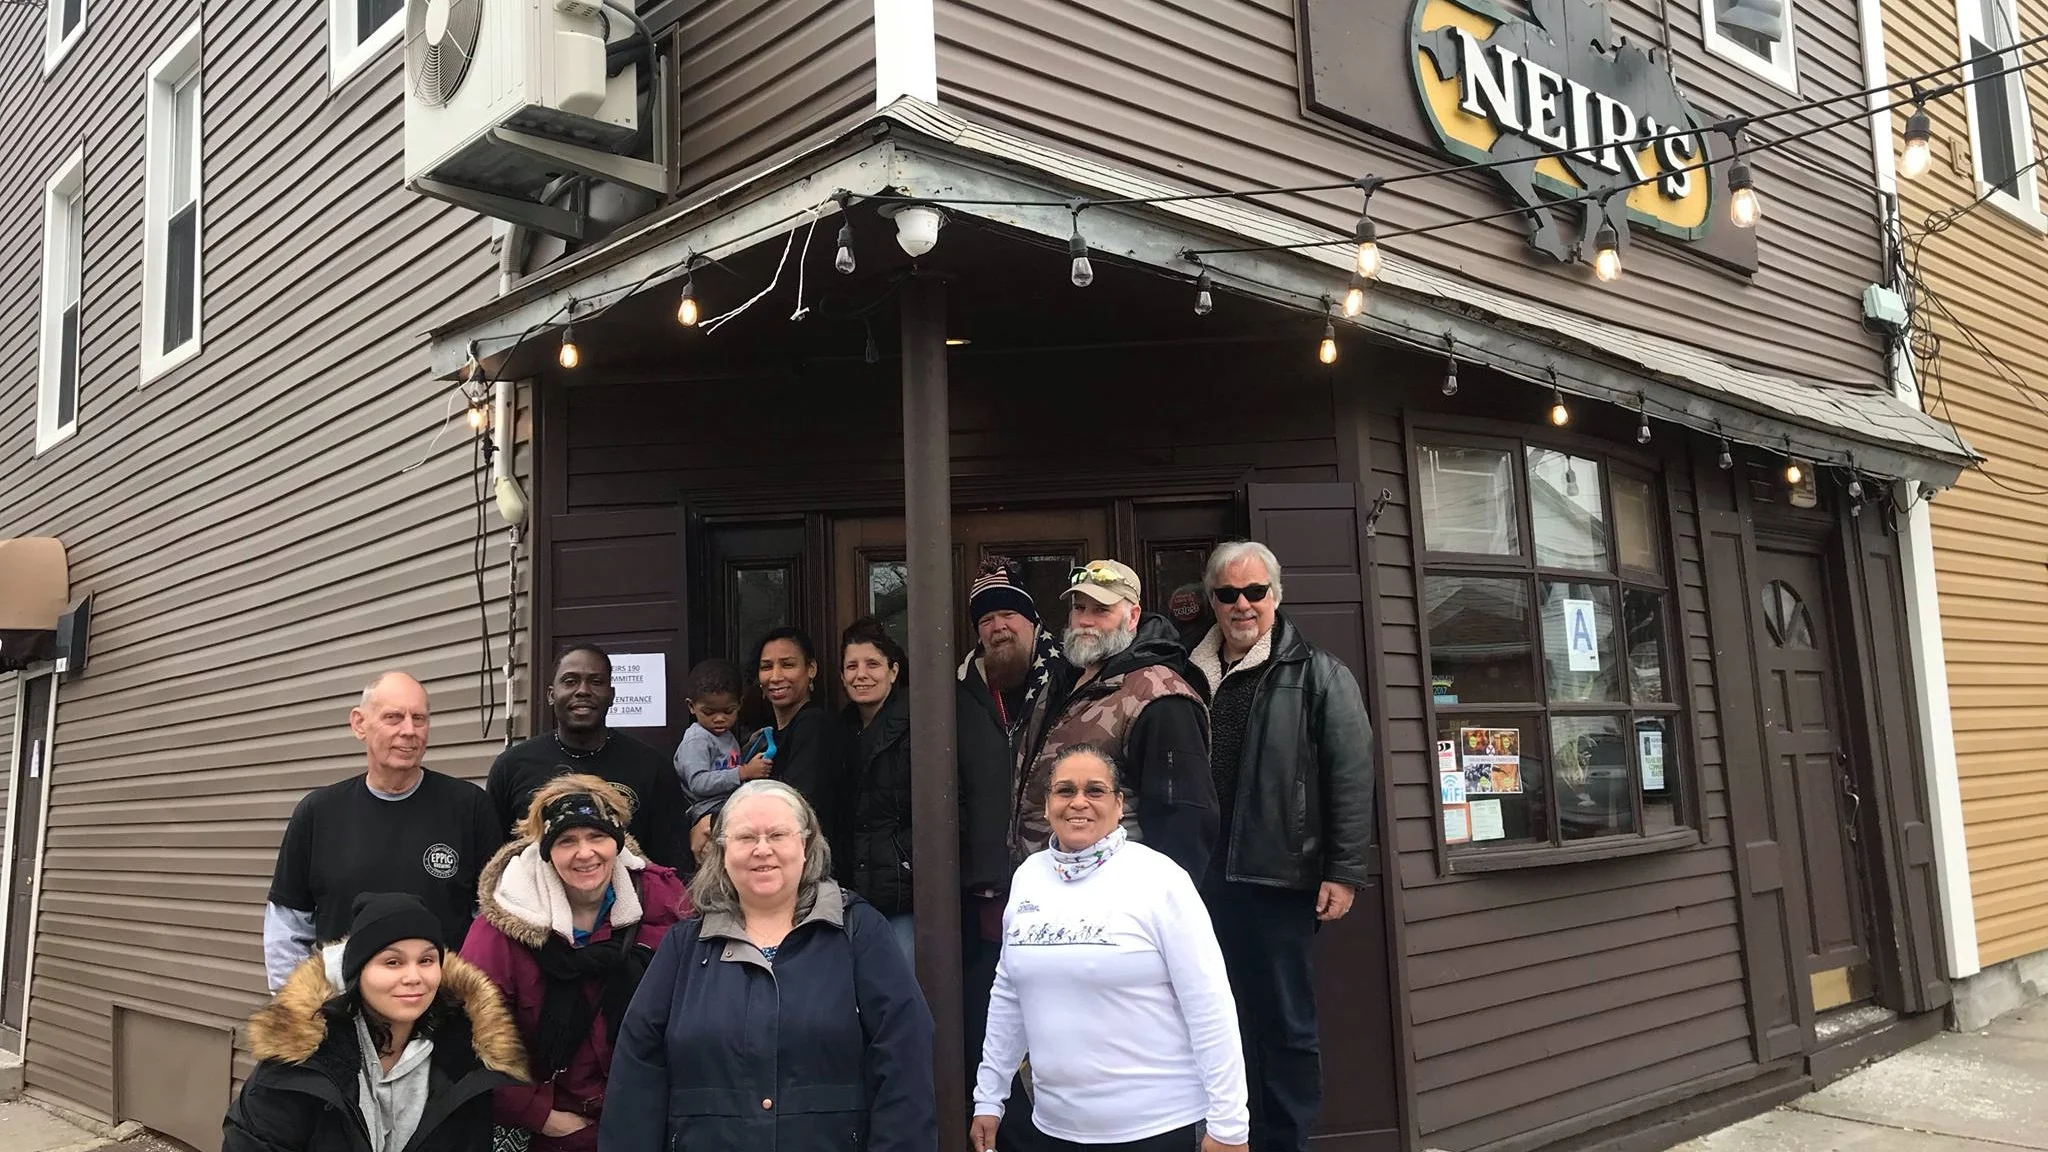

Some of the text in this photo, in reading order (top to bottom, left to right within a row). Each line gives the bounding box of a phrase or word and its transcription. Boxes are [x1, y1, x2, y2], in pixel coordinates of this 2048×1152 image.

[1454, 26, 1693, 199] NEIR'S
[1573, 608, 1593, 651] A
[615, 695, 652, 703] ENTRANCE
[431, 852, 454, 864] EPPIG
